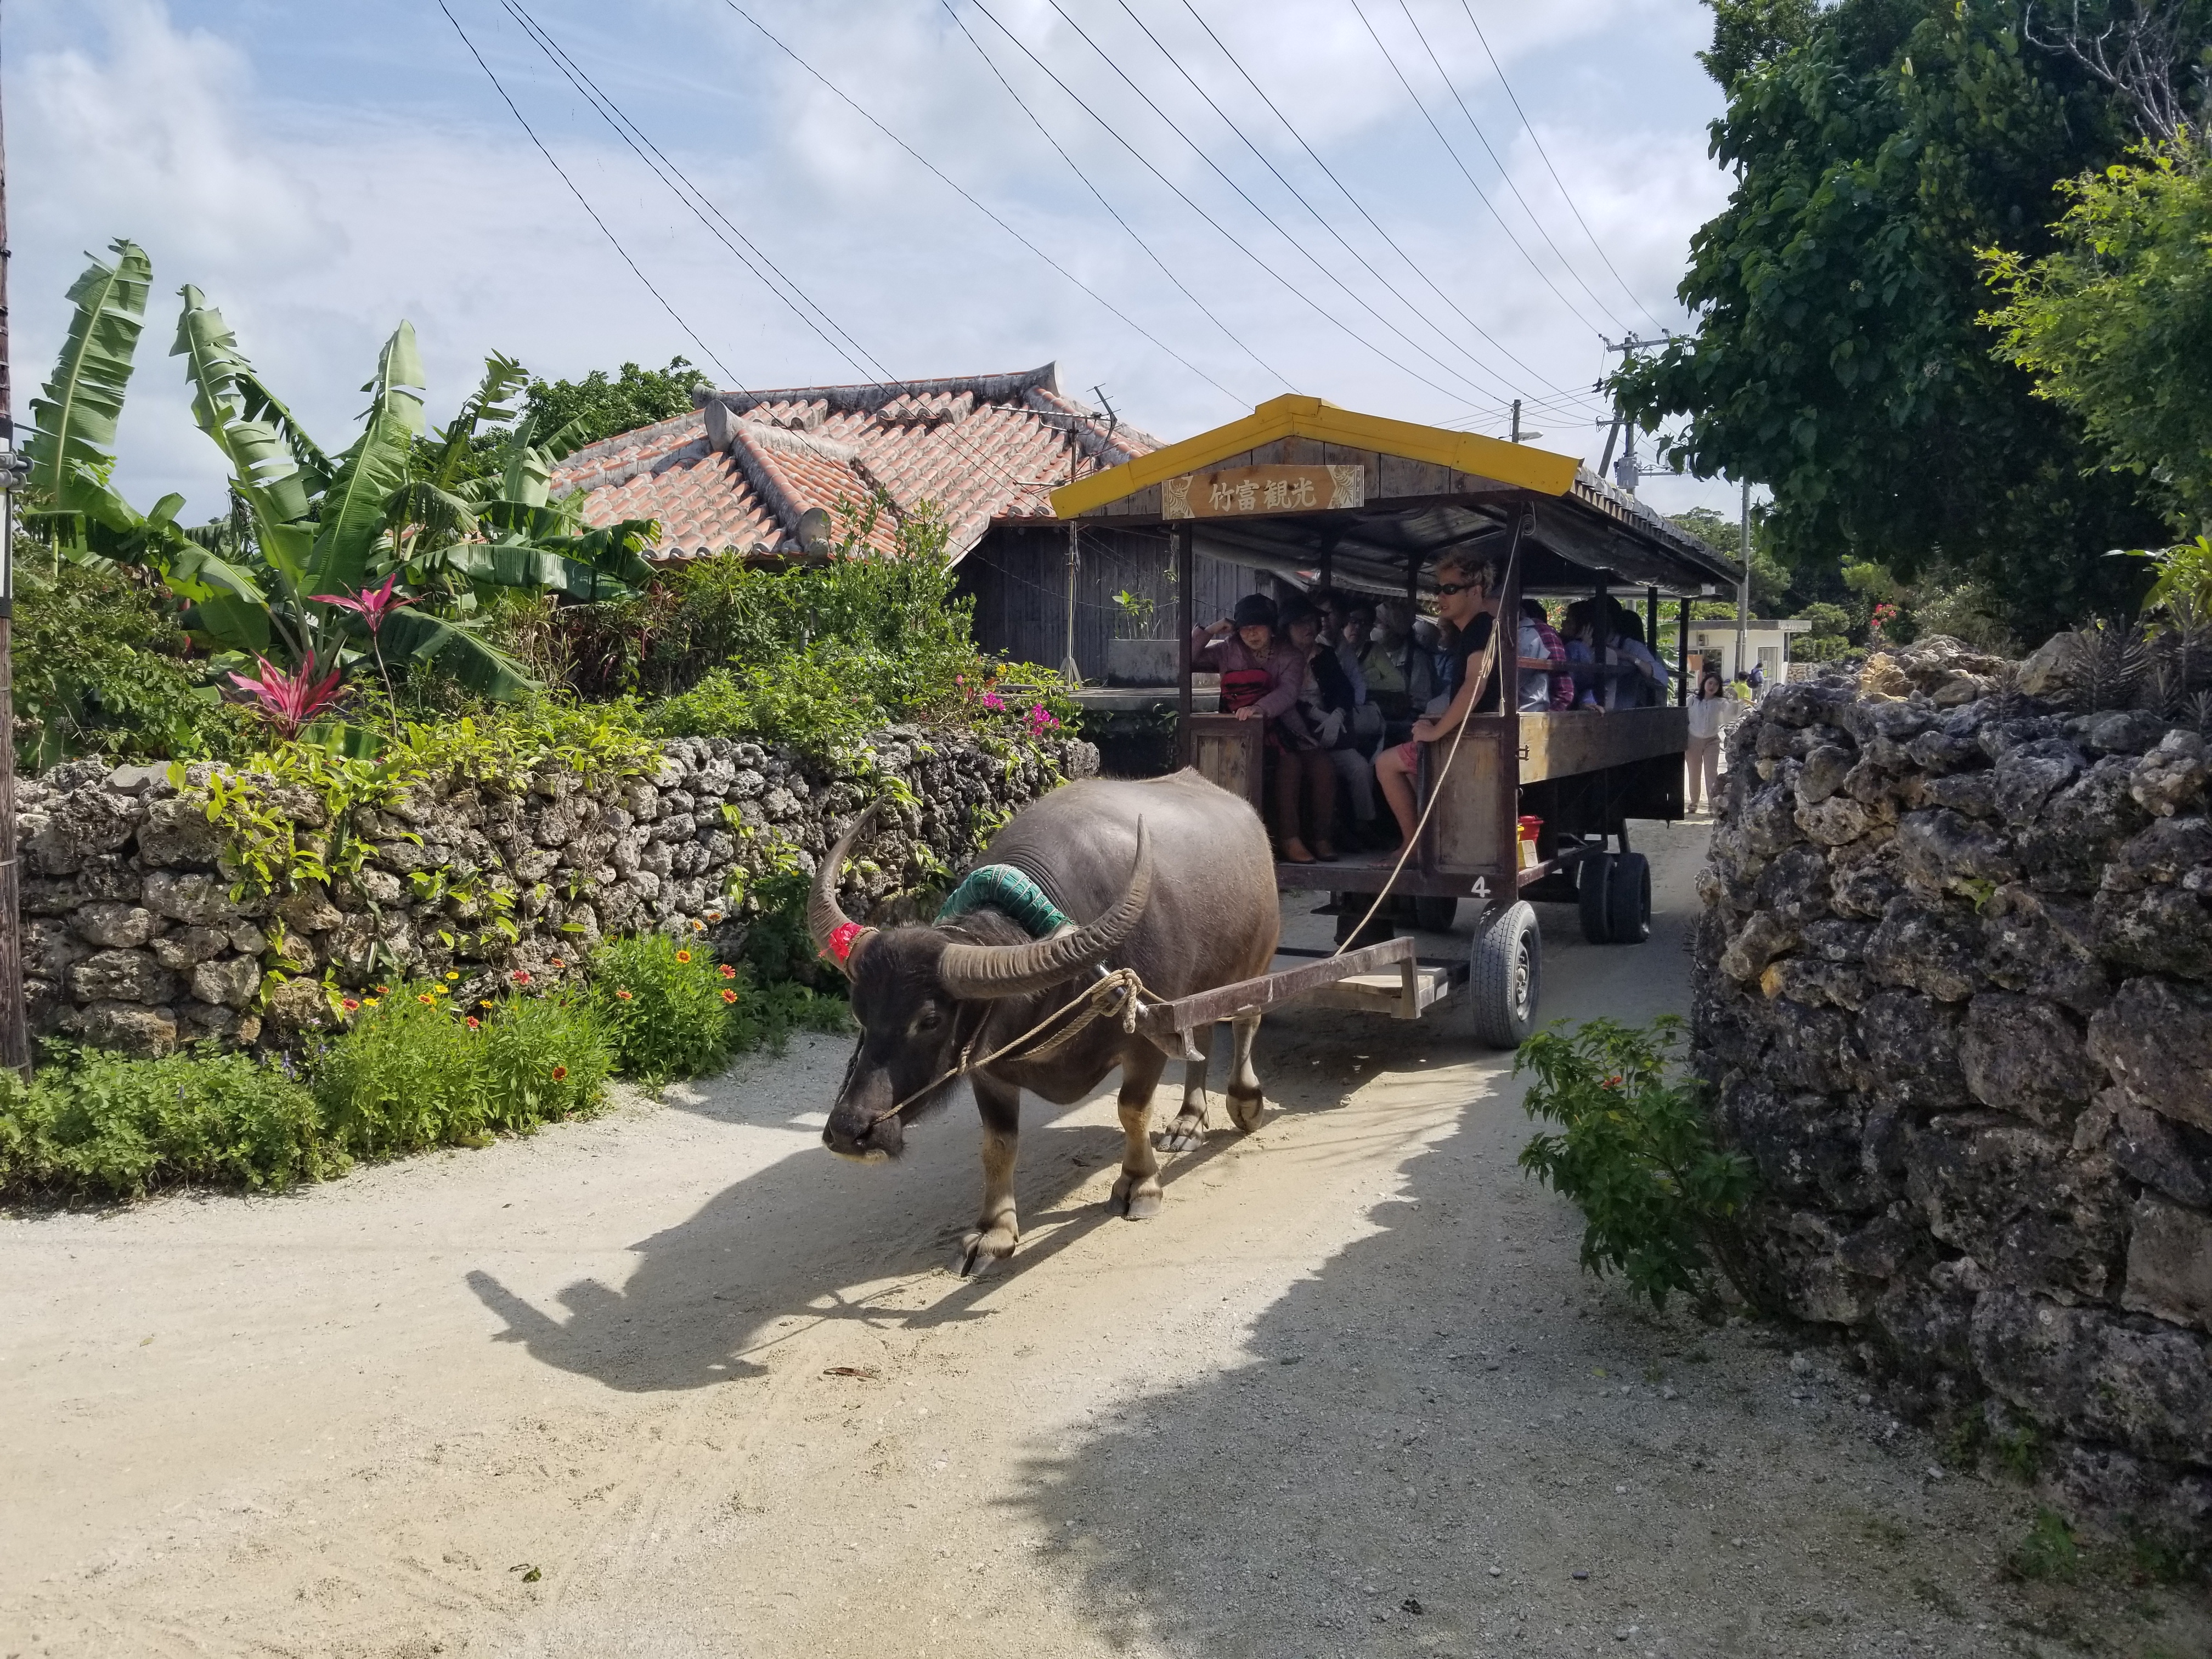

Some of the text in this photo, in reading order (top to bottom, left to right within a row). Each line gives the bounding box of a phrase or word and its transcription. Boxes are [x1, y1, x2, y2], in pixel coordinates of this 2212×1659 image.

[1209, 477, 1317, 511] 竹富観光
[1471, 876, 1491, 898] 4
